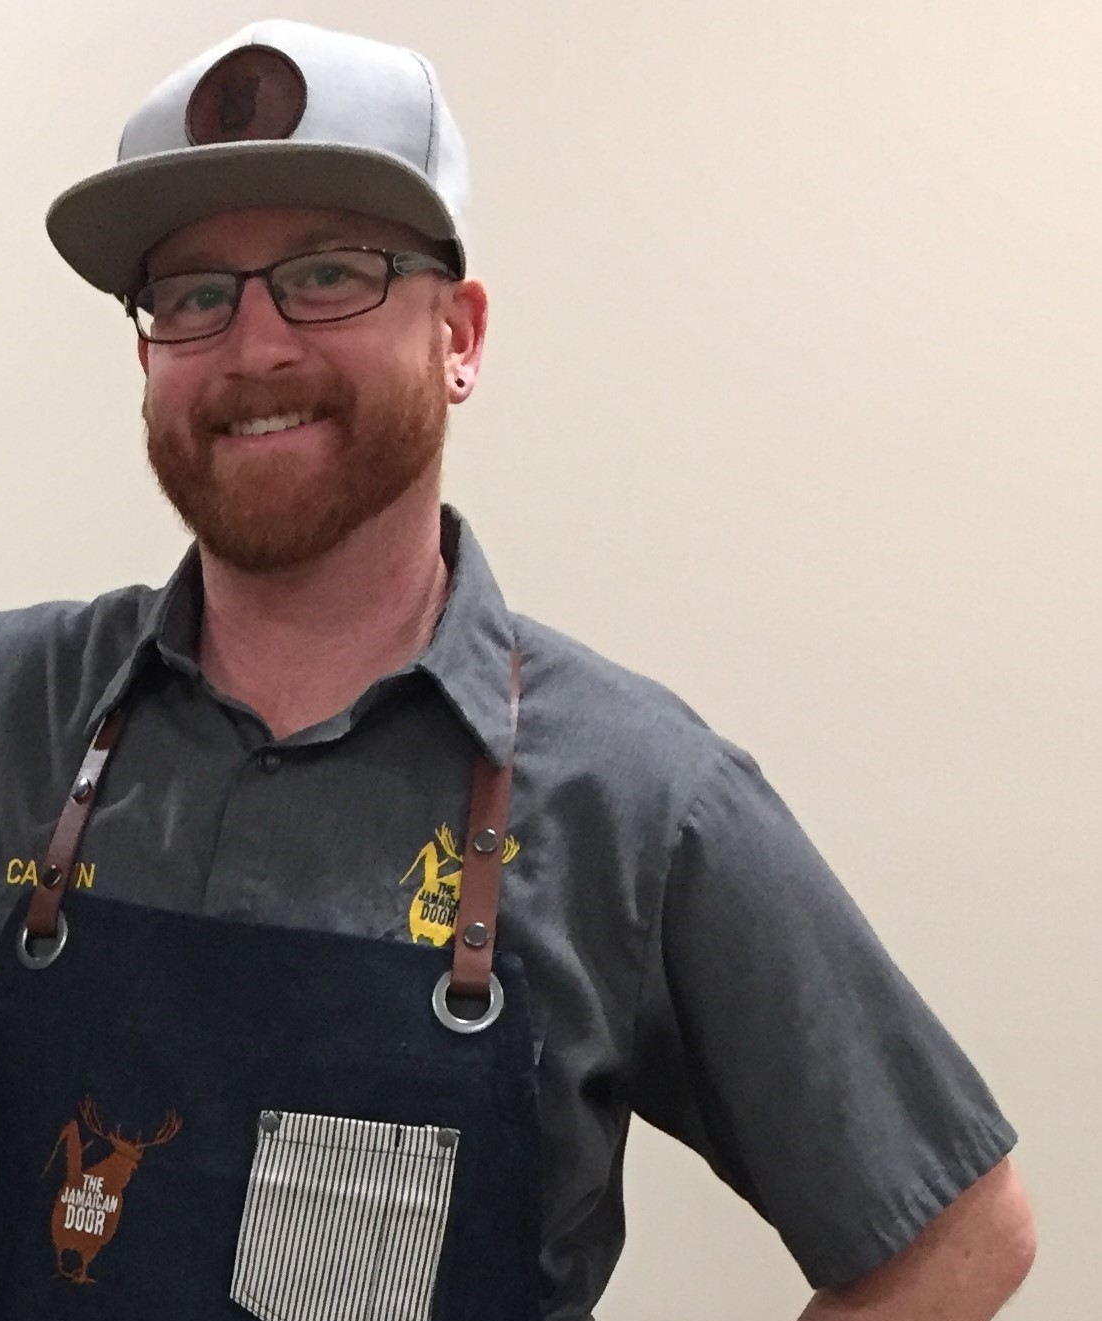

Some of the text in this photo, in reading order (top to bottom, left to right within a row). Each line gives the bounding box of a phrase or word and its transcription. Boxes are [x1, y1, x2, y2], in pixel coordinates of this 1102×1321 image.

[6, 858, 95, 888] CAN
[420, 904, 457, 927] DOOR
[83, 1174, 104, 1193] THE
[61, 1187, 118, 1213] JAMAICAN
[64, 1205, 106, 1236] DOOR
